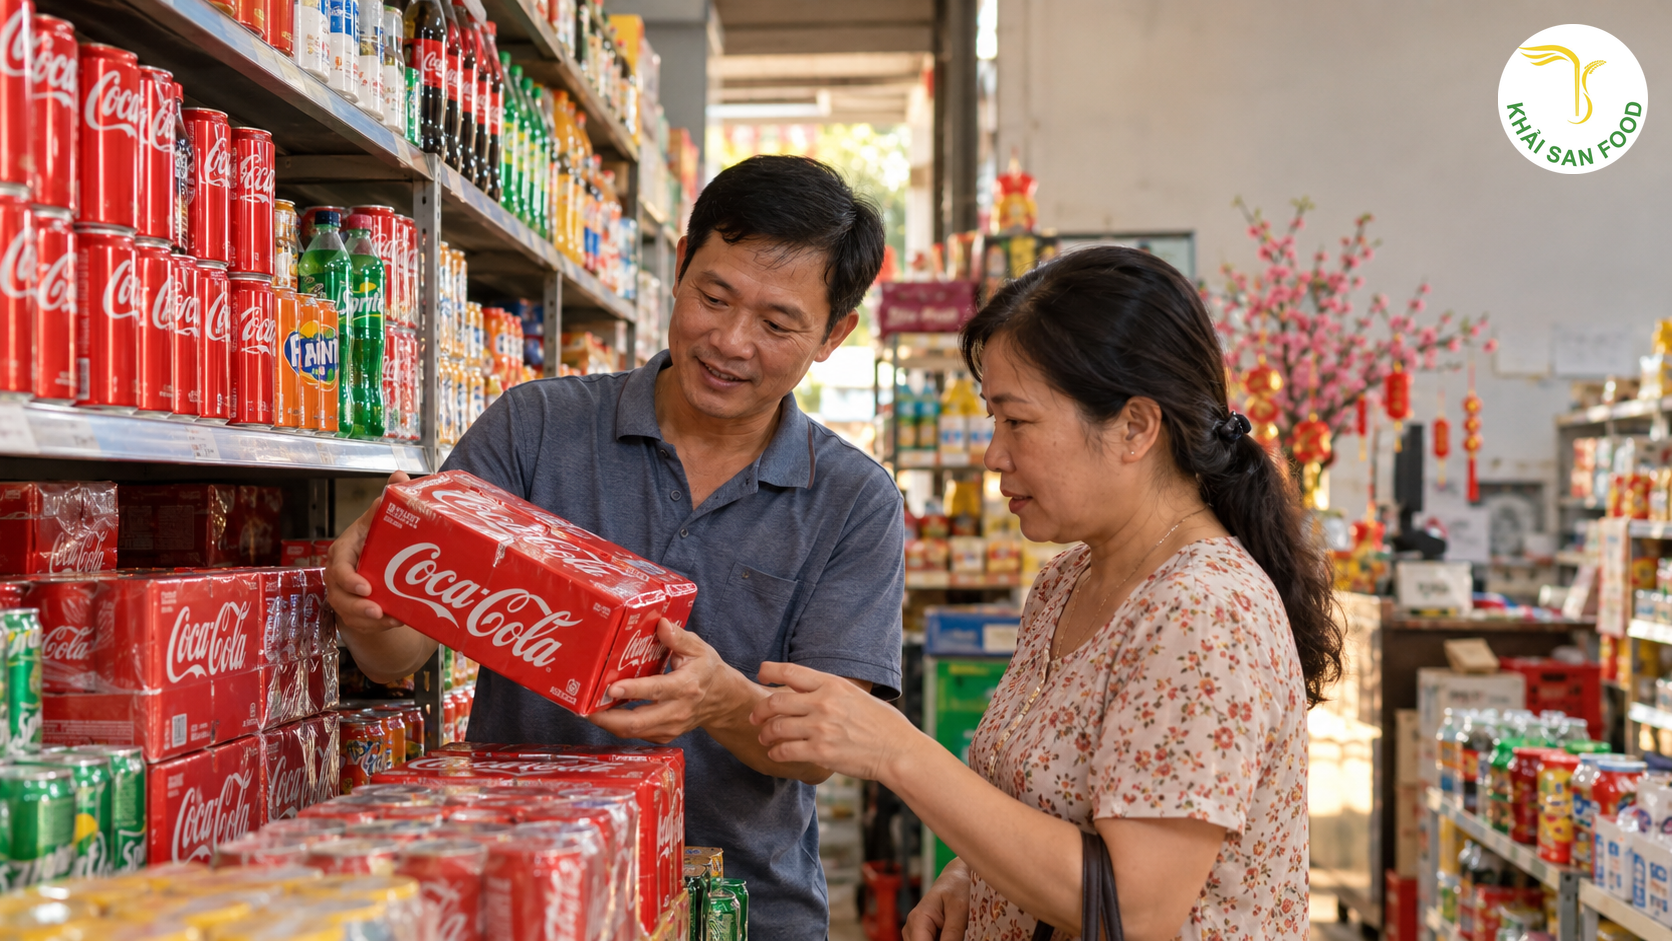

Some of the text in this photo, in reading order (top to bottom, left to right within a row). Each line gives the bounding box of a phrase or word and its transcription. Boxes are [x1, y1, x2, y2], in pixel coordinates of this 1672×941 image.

[166, 601, 252, 683] Coca-Cola
[384, 542, 583, 668] Coca-Cola
[171, 767, 253, 865] Coca-Cola
